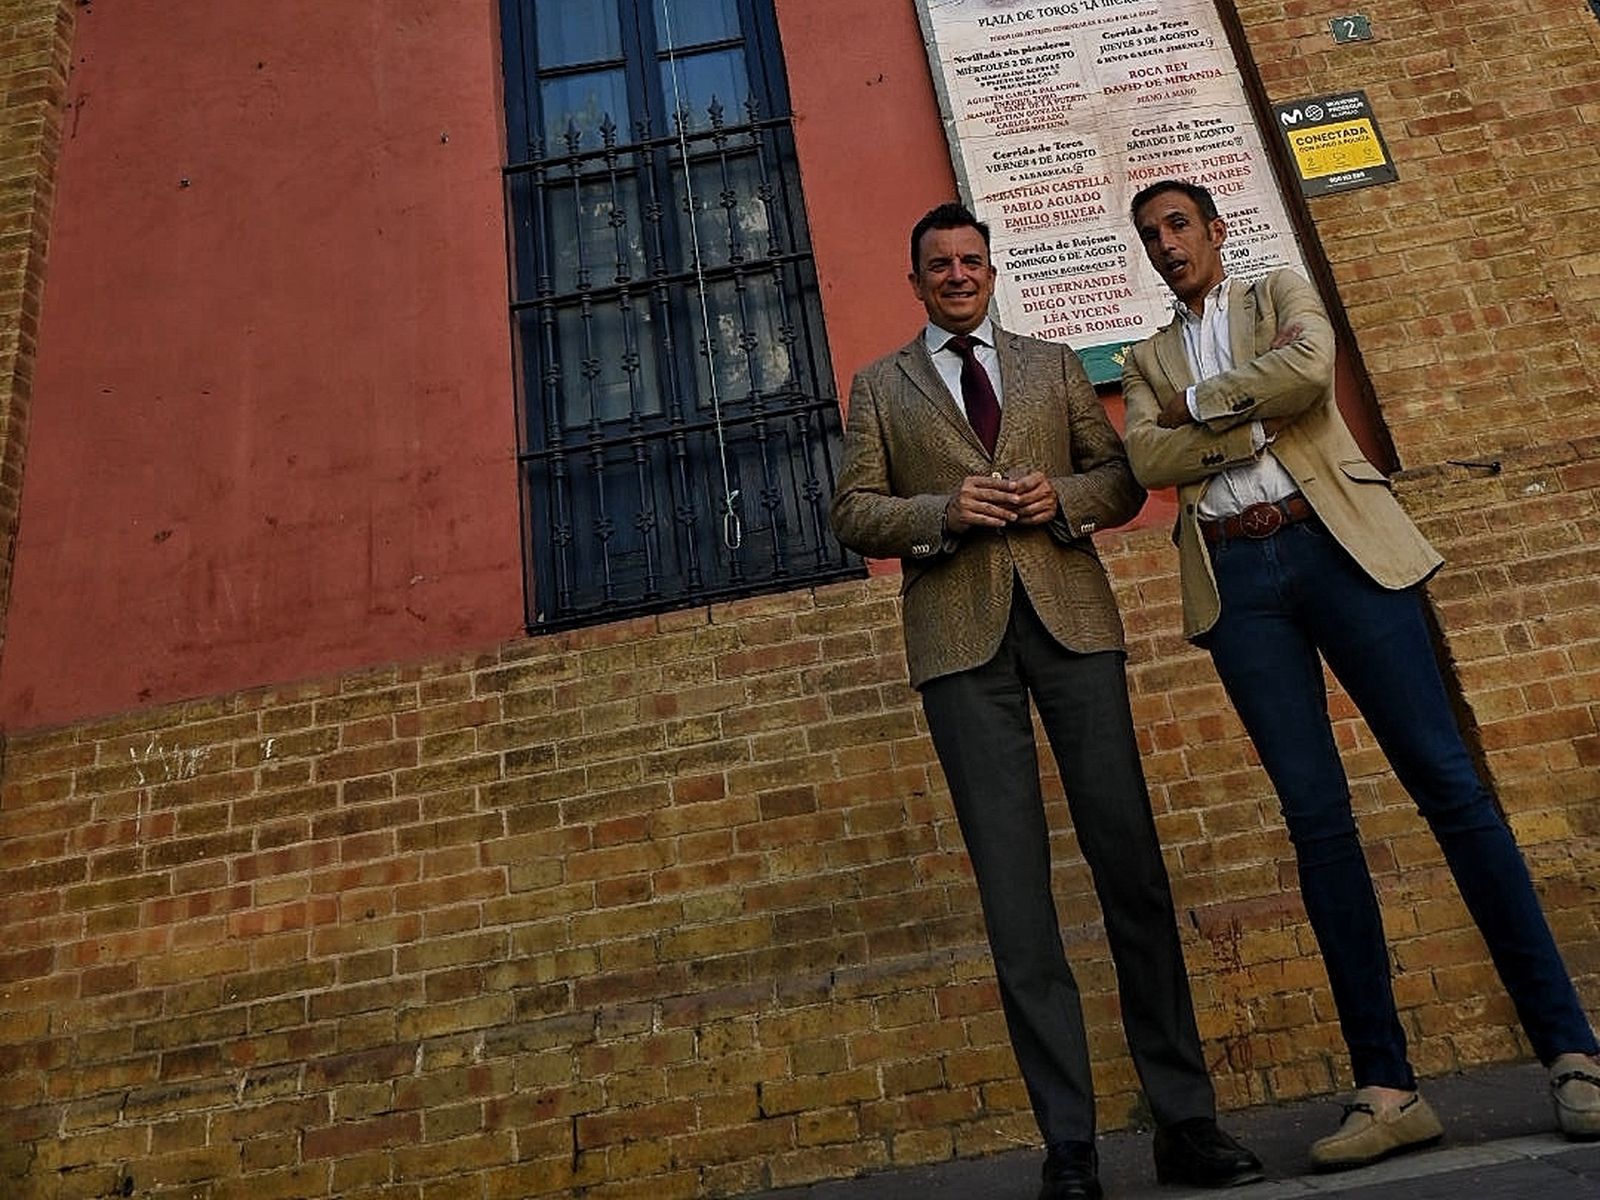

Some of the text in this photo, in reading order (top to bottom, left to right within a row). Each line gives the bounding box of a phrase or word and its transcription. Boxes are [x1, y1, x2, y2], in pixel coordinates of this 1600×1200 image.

[977, 13, 1015, 28] PLAZA
[1016, 9, 1036, 21] DE
[1037, 2, 1078, 19] TOROS
[1344, 21, 1357, 38] 2
[1129, 62, 1189, 79] ROCA REY
[1296, 127, 1368, 146] CONECTADA
[1003, 191, 1101, 214] PABLO AGUADO
[1022, 274, 1127, 299] RUI FERNANDES
[1024, 288, 1132, 313] DIEGO VENTURA
[1086, 315, 1142, 332] ROMERO
